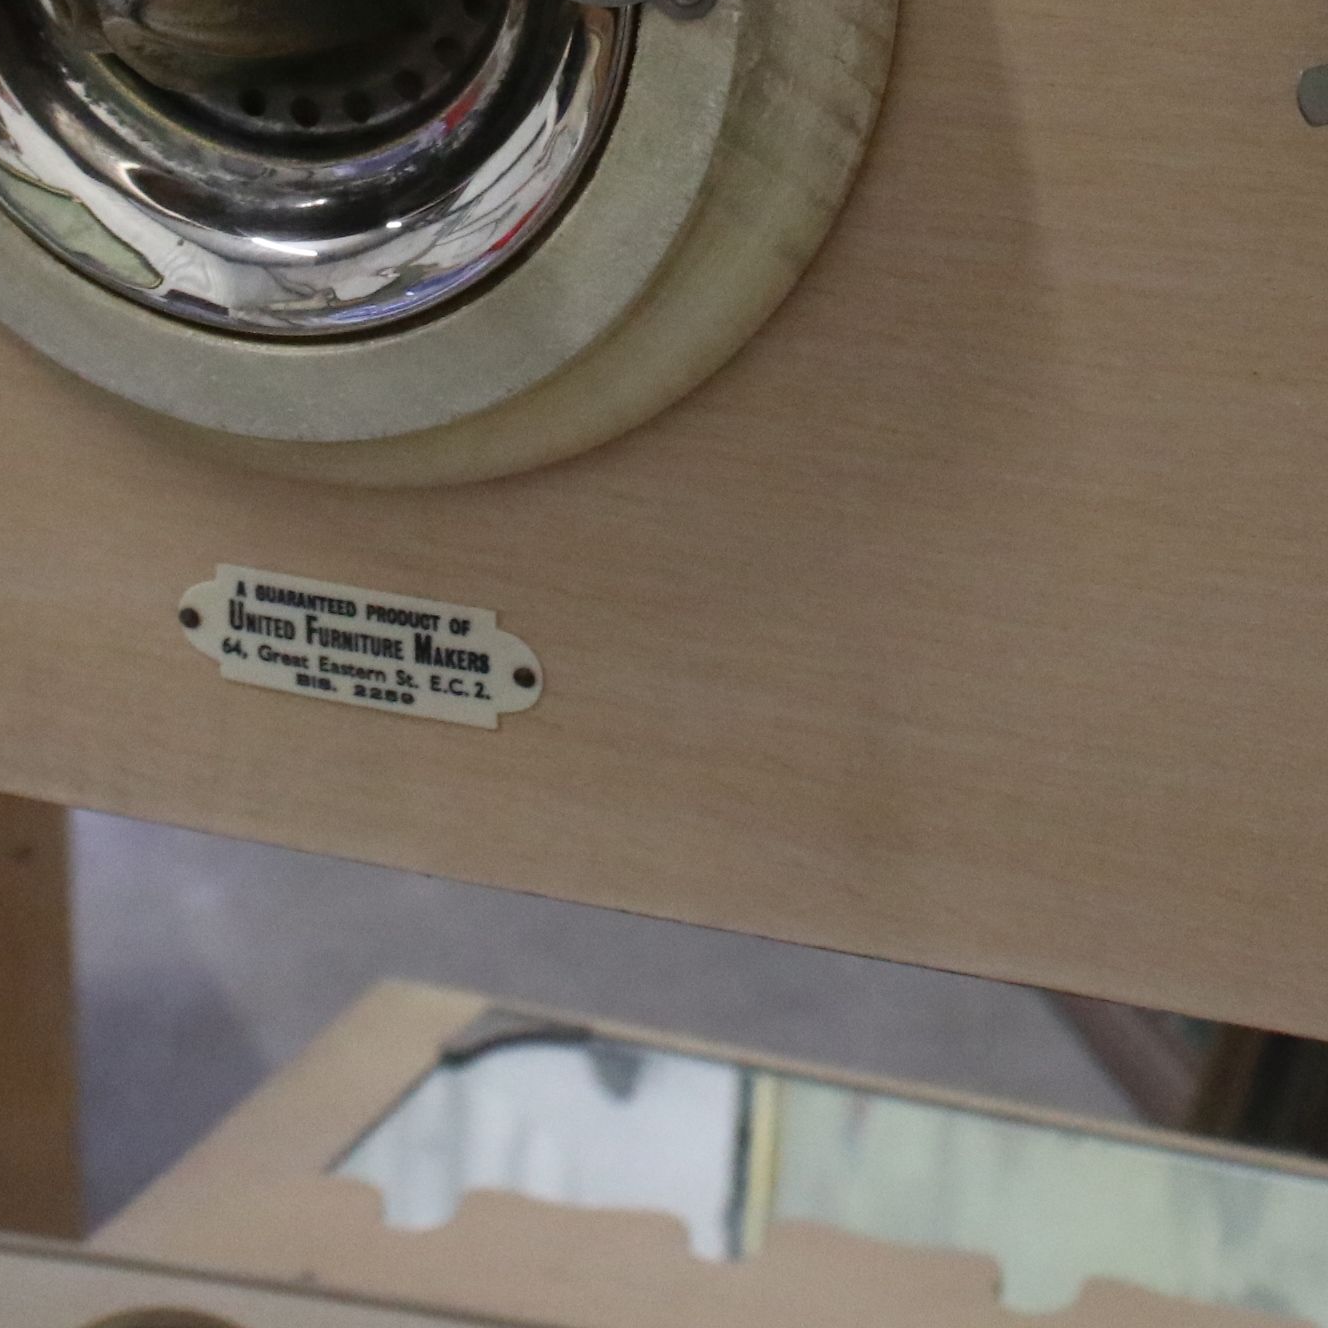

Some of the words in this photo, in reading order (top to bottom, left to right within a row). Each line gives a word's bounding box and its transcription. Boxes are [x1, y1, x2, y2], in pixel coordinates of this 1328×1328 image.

[236, 581, 246, 597] A
[256, 585, 357, 617] GUARANTEED
[367, 604, 440, 632] PRODUCT
[449, 618, 471, 636] OF
[222, 638, 247, 659] 64,
[258, 646, 309, 669] Great
[319, 657, 386, 683] Eastern
[396, 670, 418, 689] St.
[229, 600, 296, 640] UNITED
[306, 616, 403, 660] FURNITURE
[414, 633, 490, 674] MAKERS
